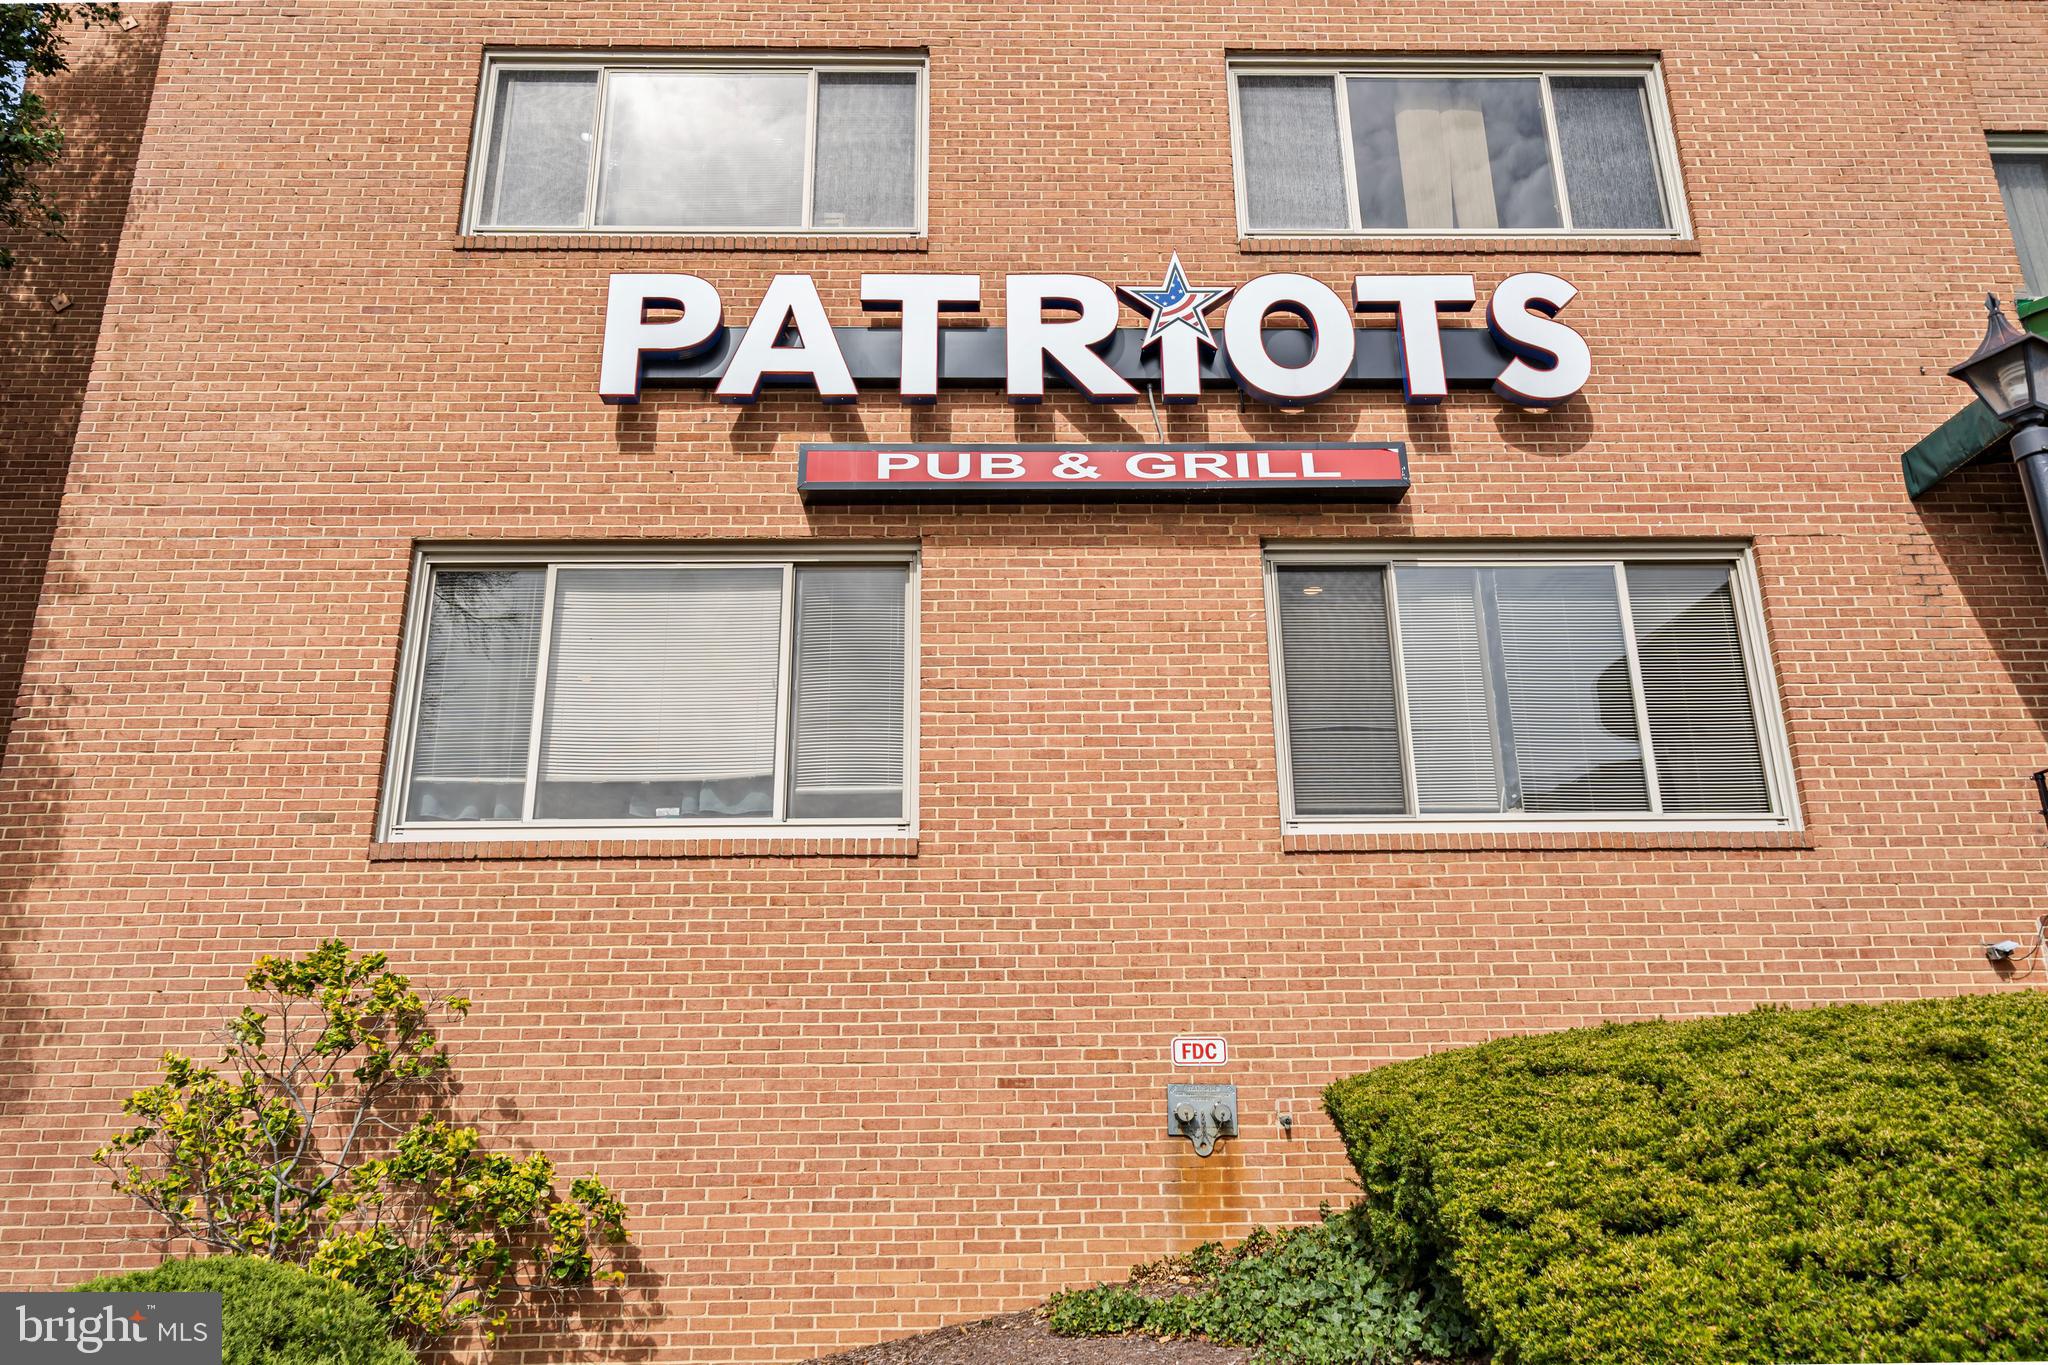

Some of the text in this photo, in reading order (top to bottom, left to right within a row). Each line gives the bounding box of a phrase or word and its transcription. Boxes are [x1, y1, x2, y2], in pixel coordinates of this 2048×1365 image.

[599, 249, 1592, 402] PATRIOTS
[877, 452, 1341, 480] PUB & GRILL
[1181, 1042, 1217, 1060] FDC
